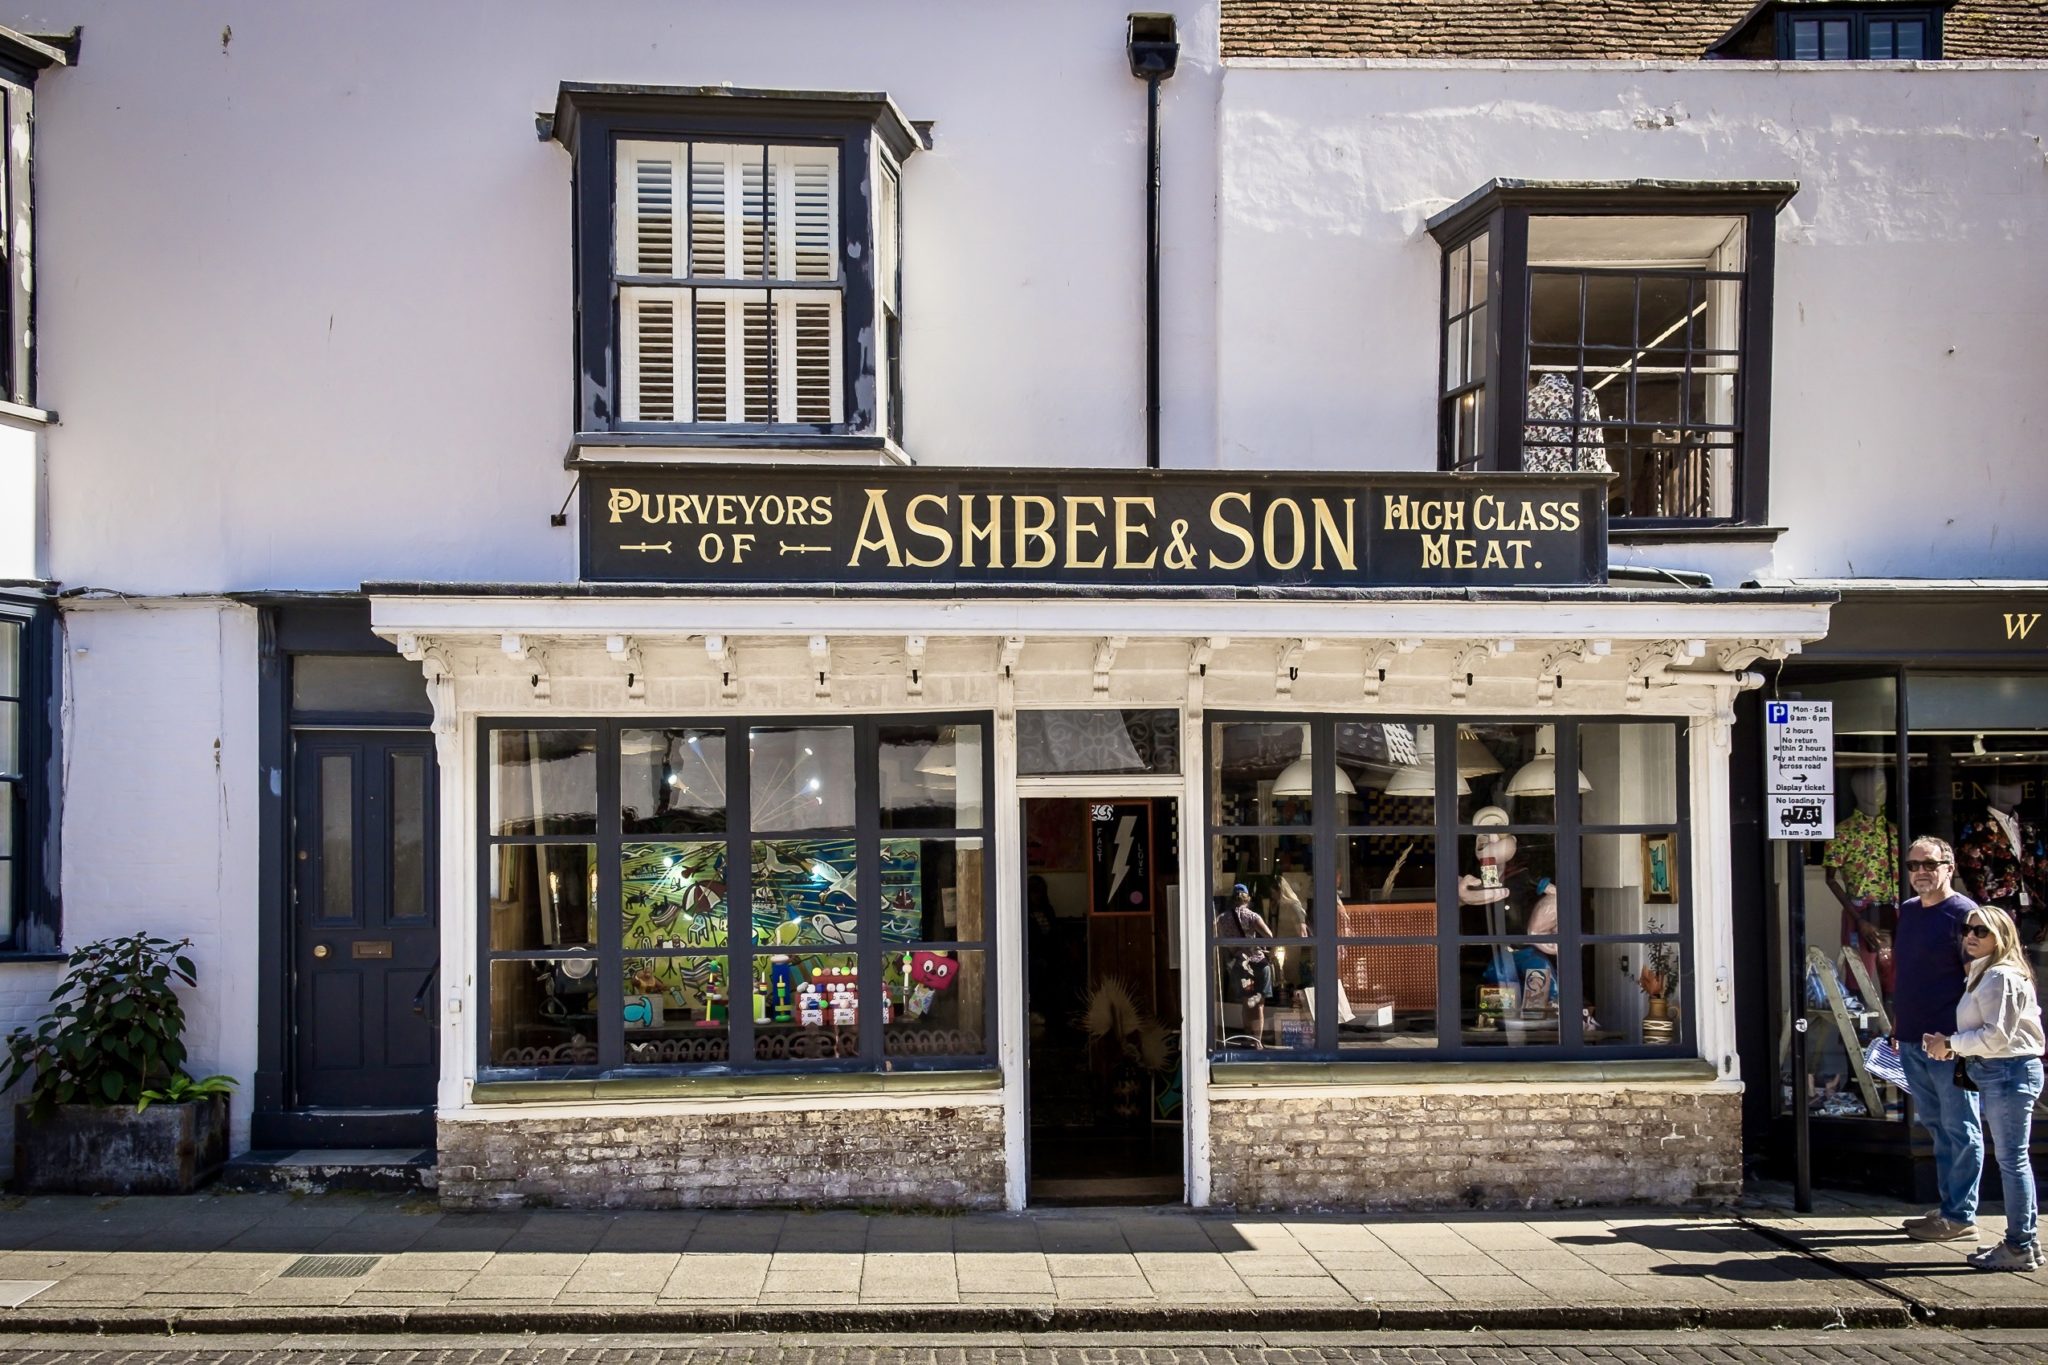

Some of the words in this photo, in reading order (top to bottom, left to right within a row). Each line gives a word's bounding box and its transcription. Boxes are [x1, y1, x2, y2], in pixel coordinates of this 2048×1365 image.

[608, 488, 833, 525] PURVEYORS
[1383, 494, 1465, 531] HIGH
[1472, 494, 1581, 532] CLASS
[847, 488, 1159, 569] ASHBEE
[1162, 518, 1198, 570] &
[1208, 491, 1358, 571] SON
[698, 532, 755, 564] OF
[1421, 533, 1543, 569] MEAT.
[2002, 613, 2042, 640] W
[1773, 705, 1785, 722] P
[1814, 705, 1827, 713] Sat
[1772, 754, 1786, 762] Pay
[1773, 744, 1797, 752] wthin
[1798, 744, 1804, 752] 2
[1775, 784, 1803, 792] Display
[1788, 797, 1815, 805] loading
[1816, 797, 1827, 805] by
